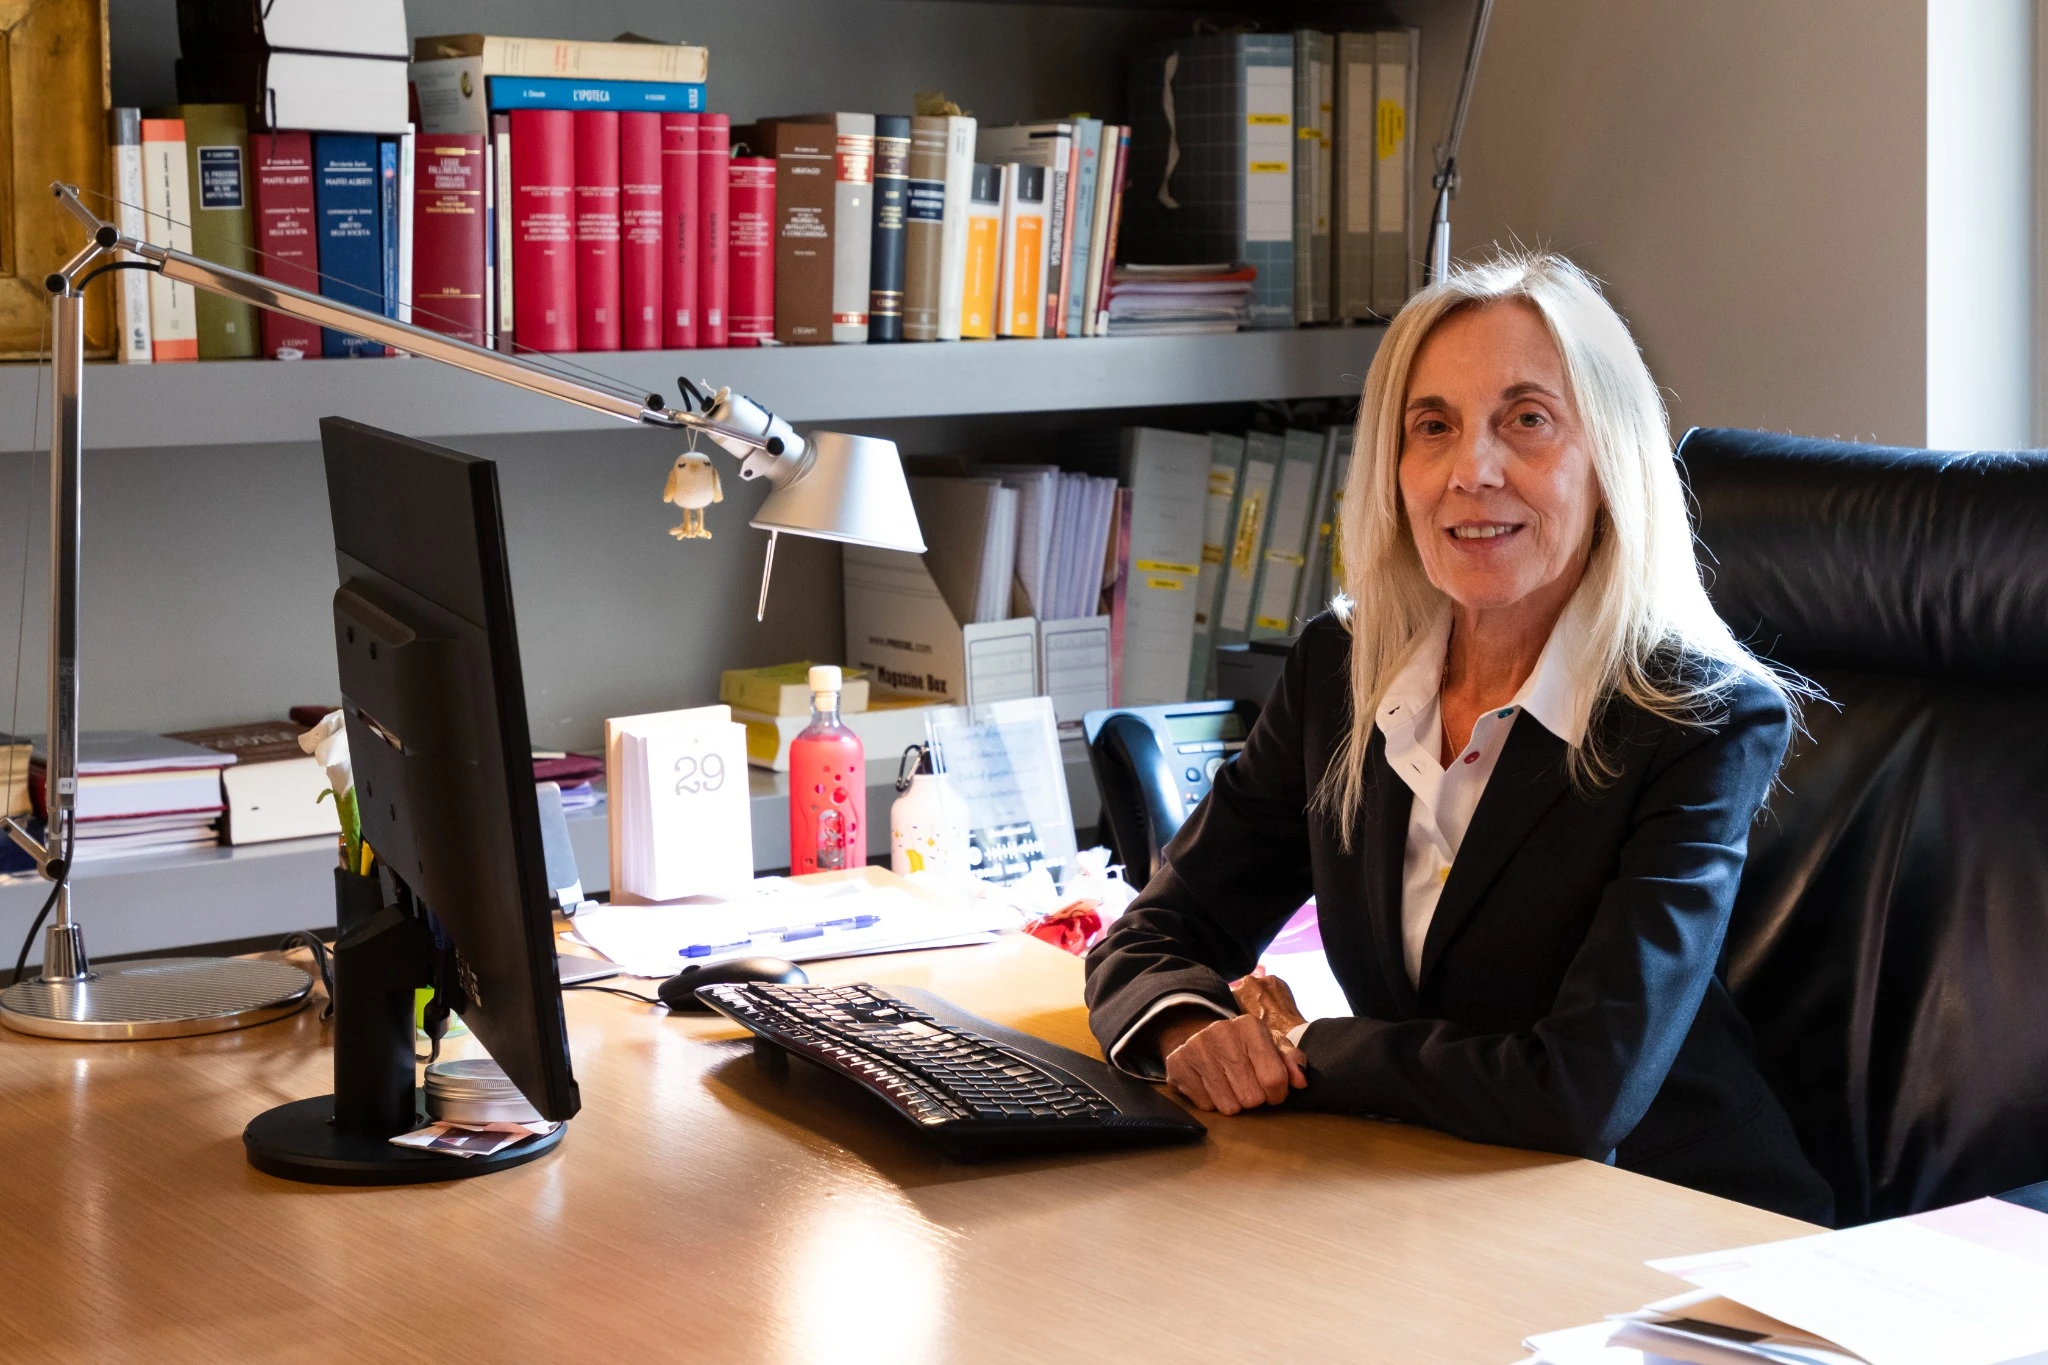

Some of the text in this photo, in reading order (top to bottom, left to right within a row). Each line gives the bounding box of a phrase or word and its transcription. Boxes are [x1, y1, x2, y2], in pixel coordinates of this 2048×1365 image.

[573, 89, 610, 102] L'IPOTECA
[877, 666, 947, 694] Magazine Box
[674, 753, 725, 796] 29
